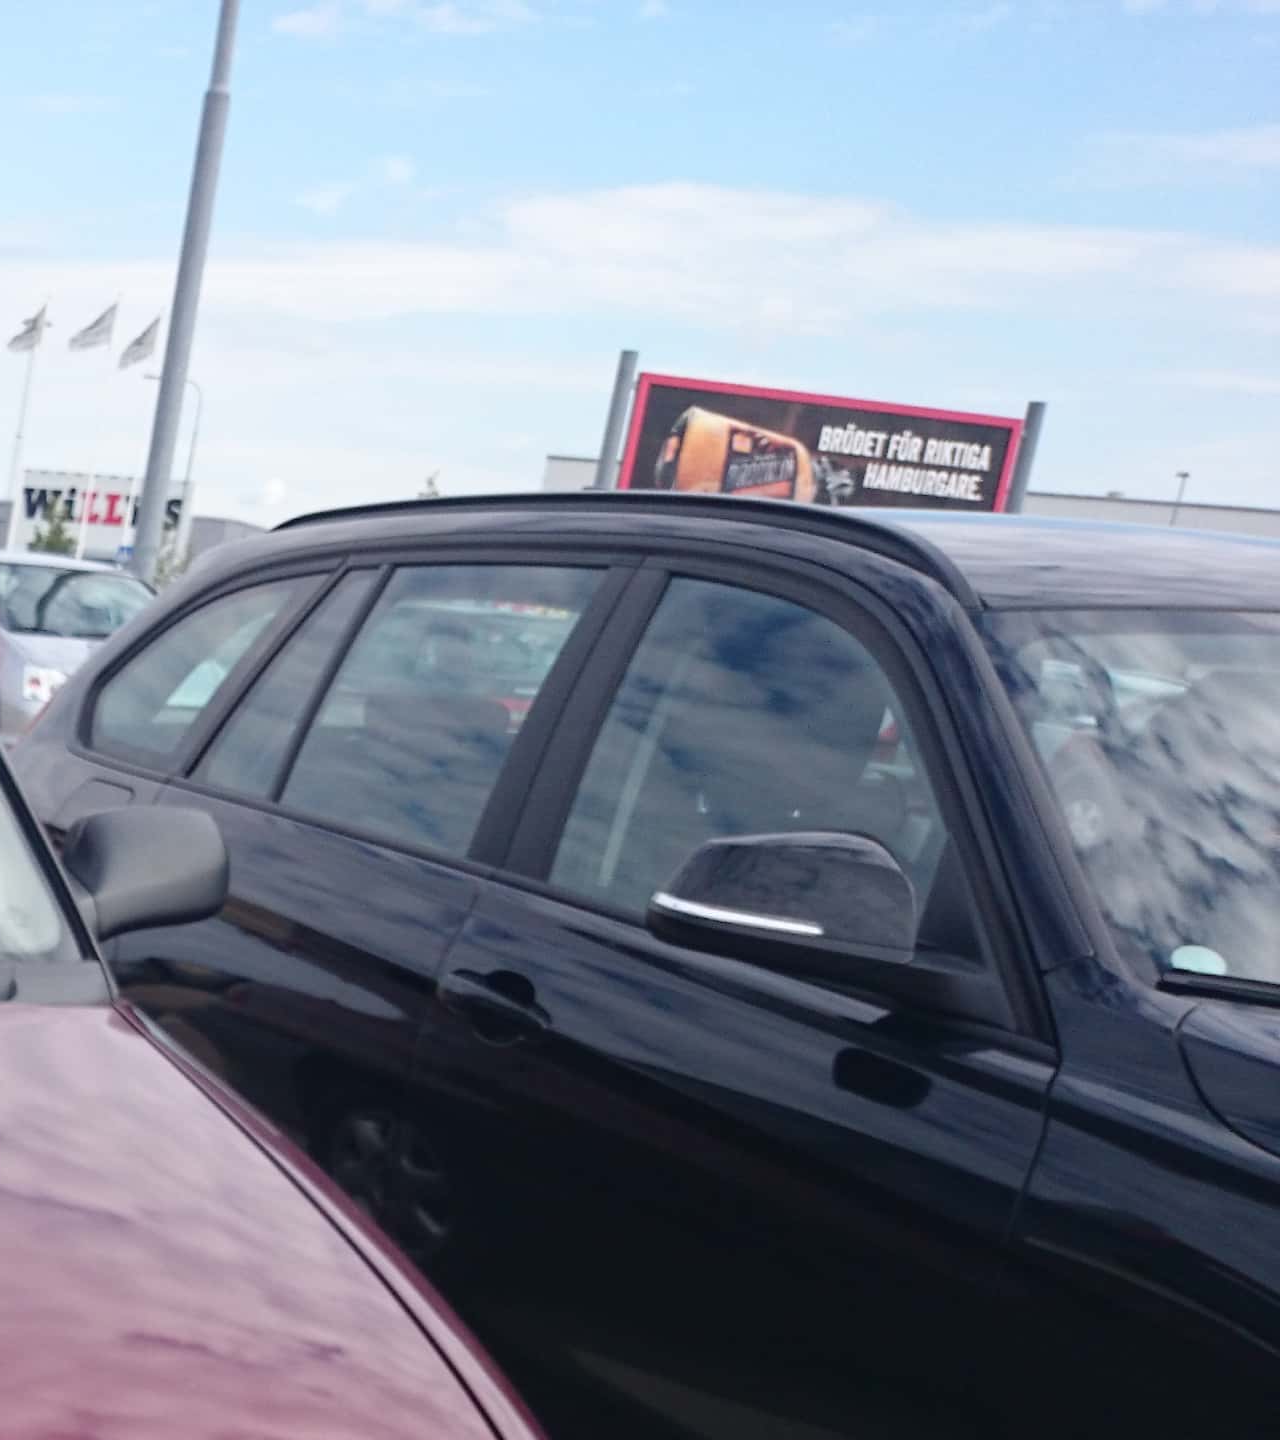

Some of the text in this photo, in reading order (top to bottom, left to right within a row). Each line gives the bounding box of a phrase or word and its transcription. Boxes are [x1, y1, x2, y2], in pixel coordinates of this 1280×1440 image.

[817, 422, 993, 472] BRÖDET FÖR RIKTIGA
